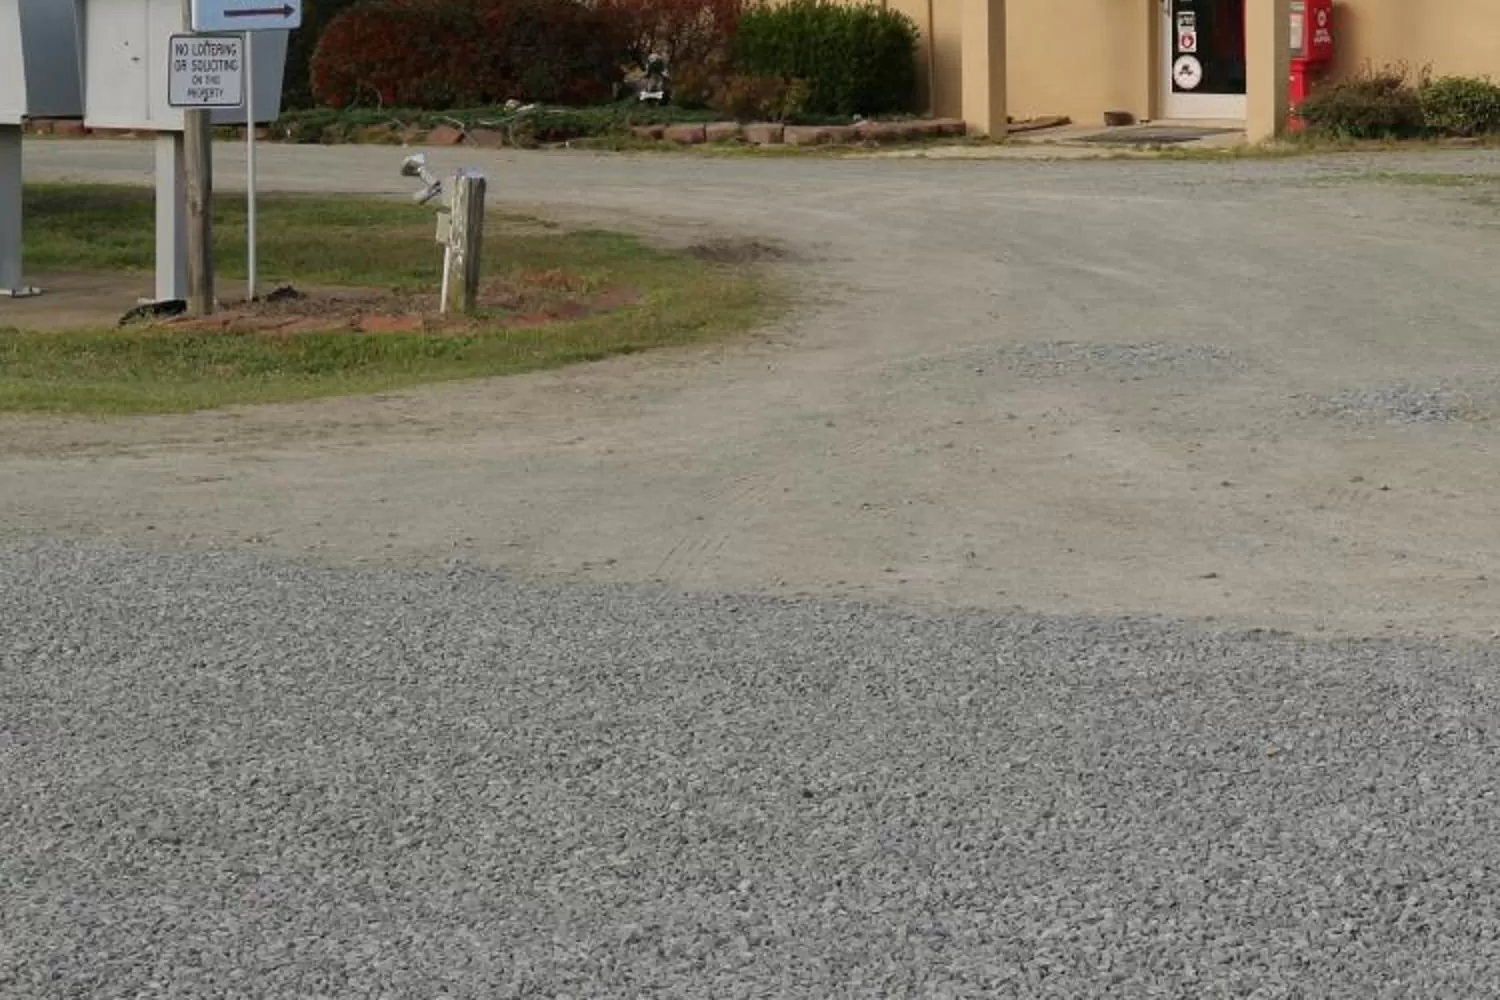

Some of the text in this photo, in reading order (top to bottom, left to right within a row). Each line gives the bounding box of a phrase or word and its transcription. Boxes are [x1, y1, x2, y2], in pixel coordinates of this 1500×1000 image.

[175, 43, 237, 56] NO LOITERING
[175, 60, 187, 72] OR
